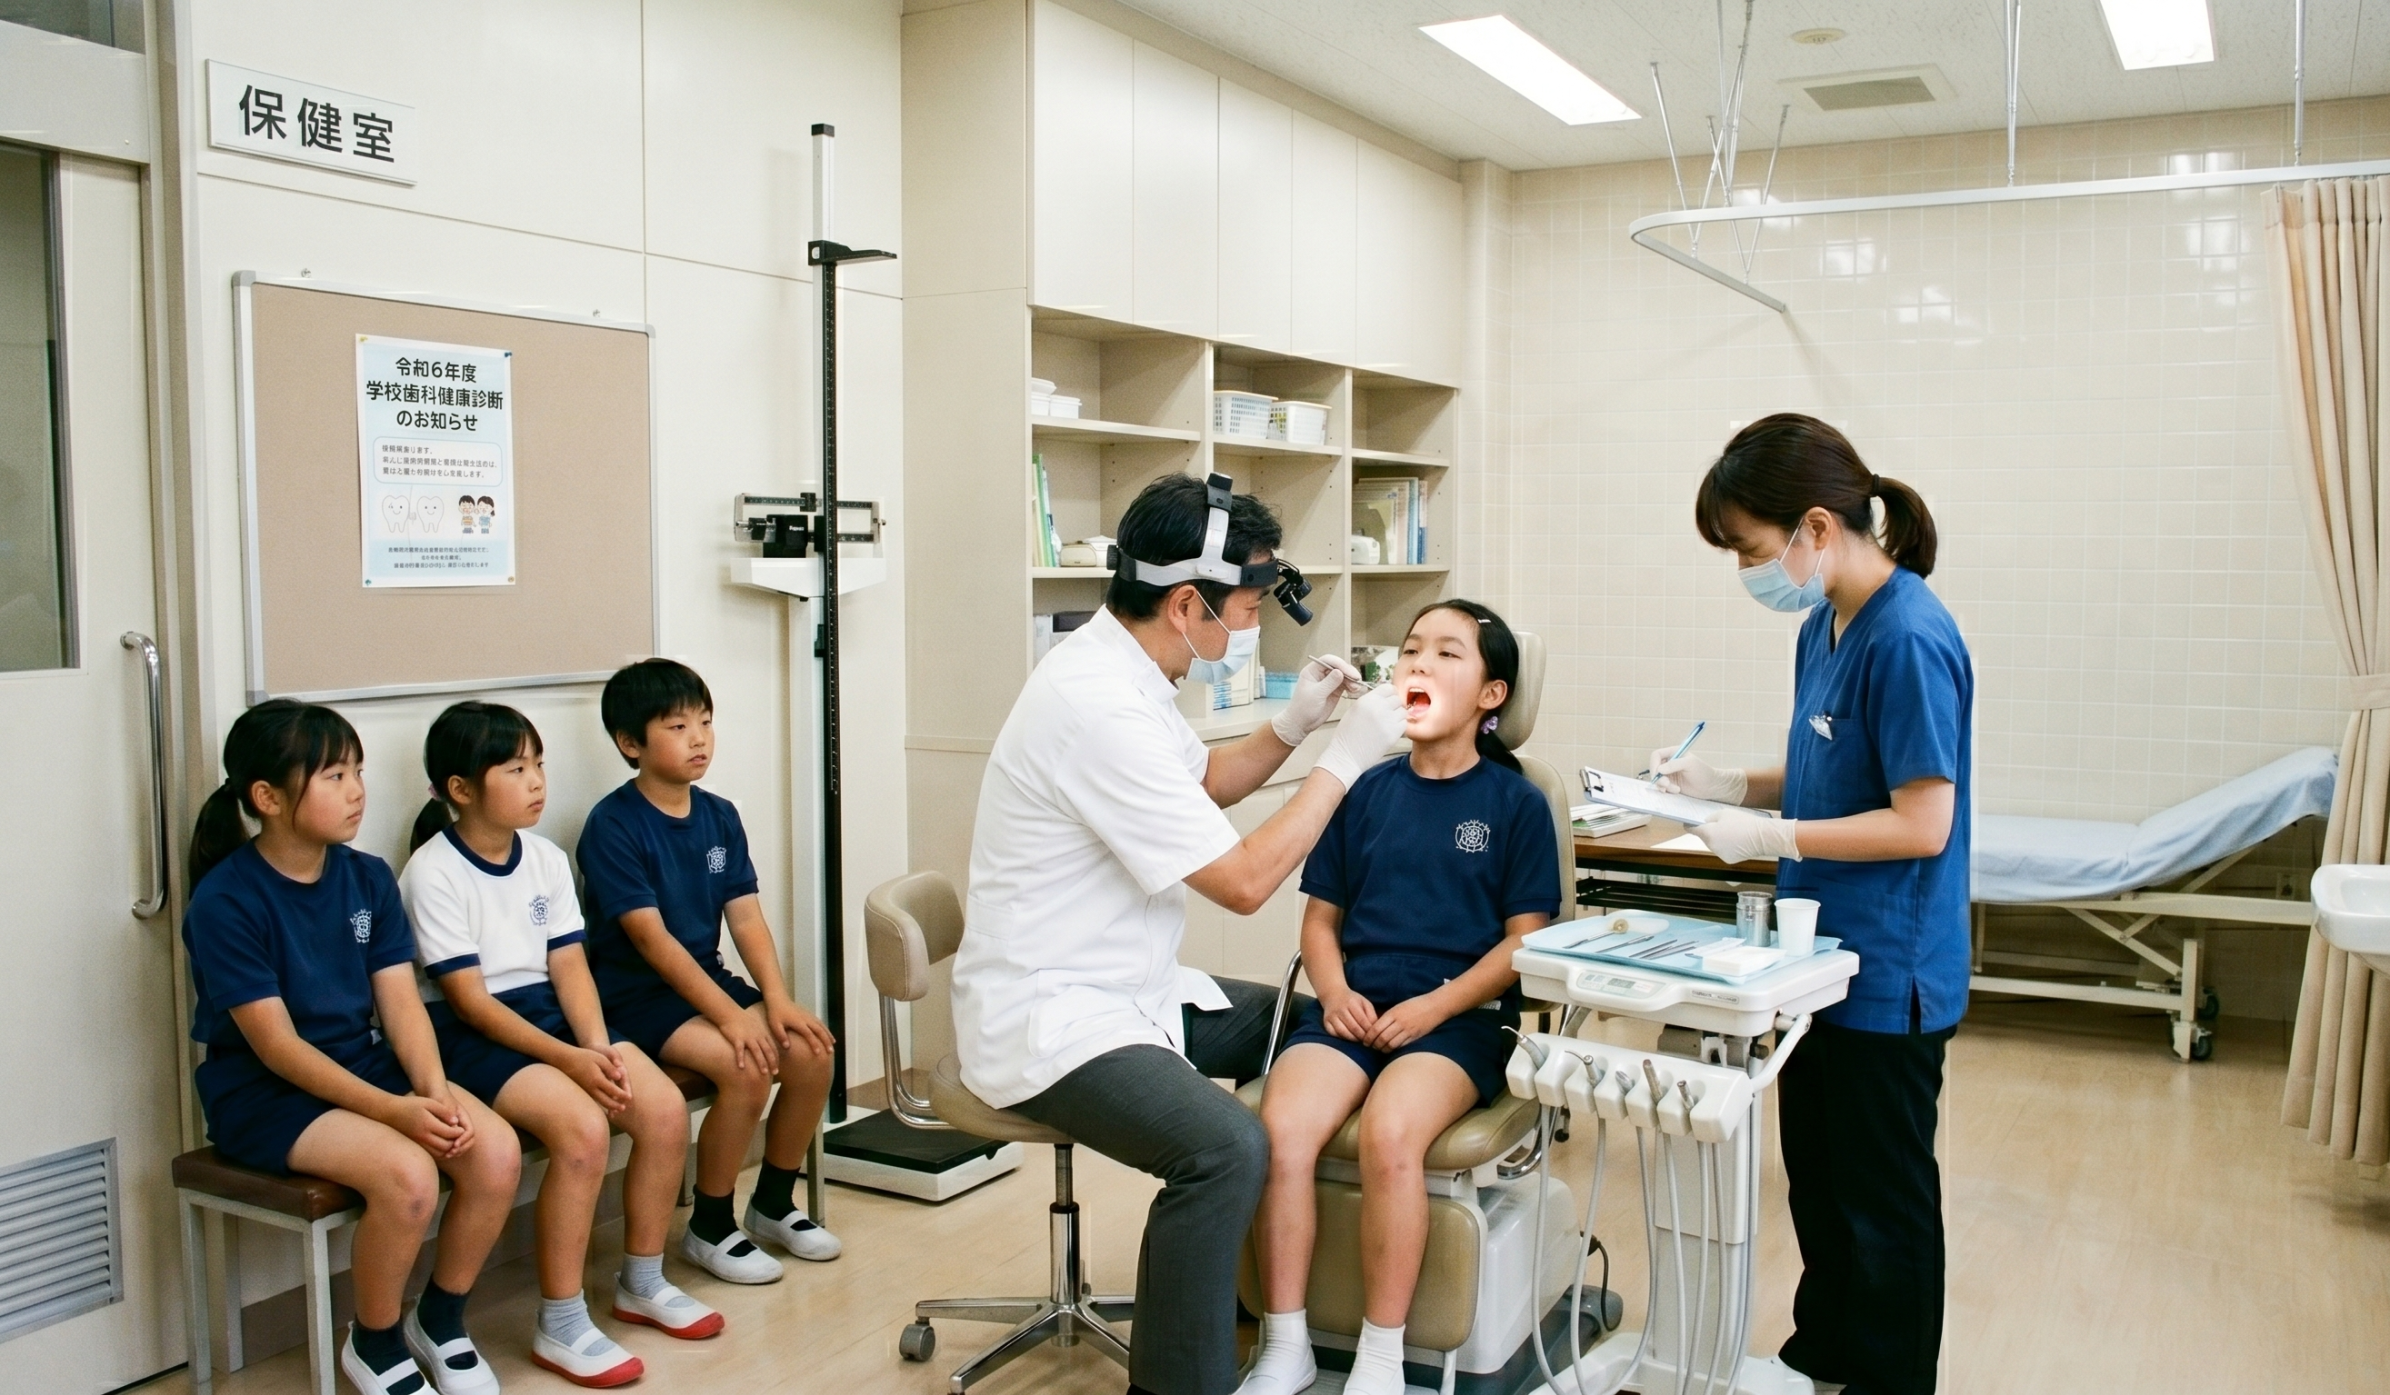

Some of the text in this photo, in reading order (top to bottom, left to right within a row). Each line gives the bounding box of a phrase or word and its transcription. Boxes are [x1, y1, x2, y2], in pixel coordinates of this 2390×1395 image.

[239, 84, 394, 163] 保健室
[395, 356, 477, 383] 令和6年度
[365, 380, 503, 410] 学校歯科健康診断
[396, 410, 478, 432] のお知らせ
